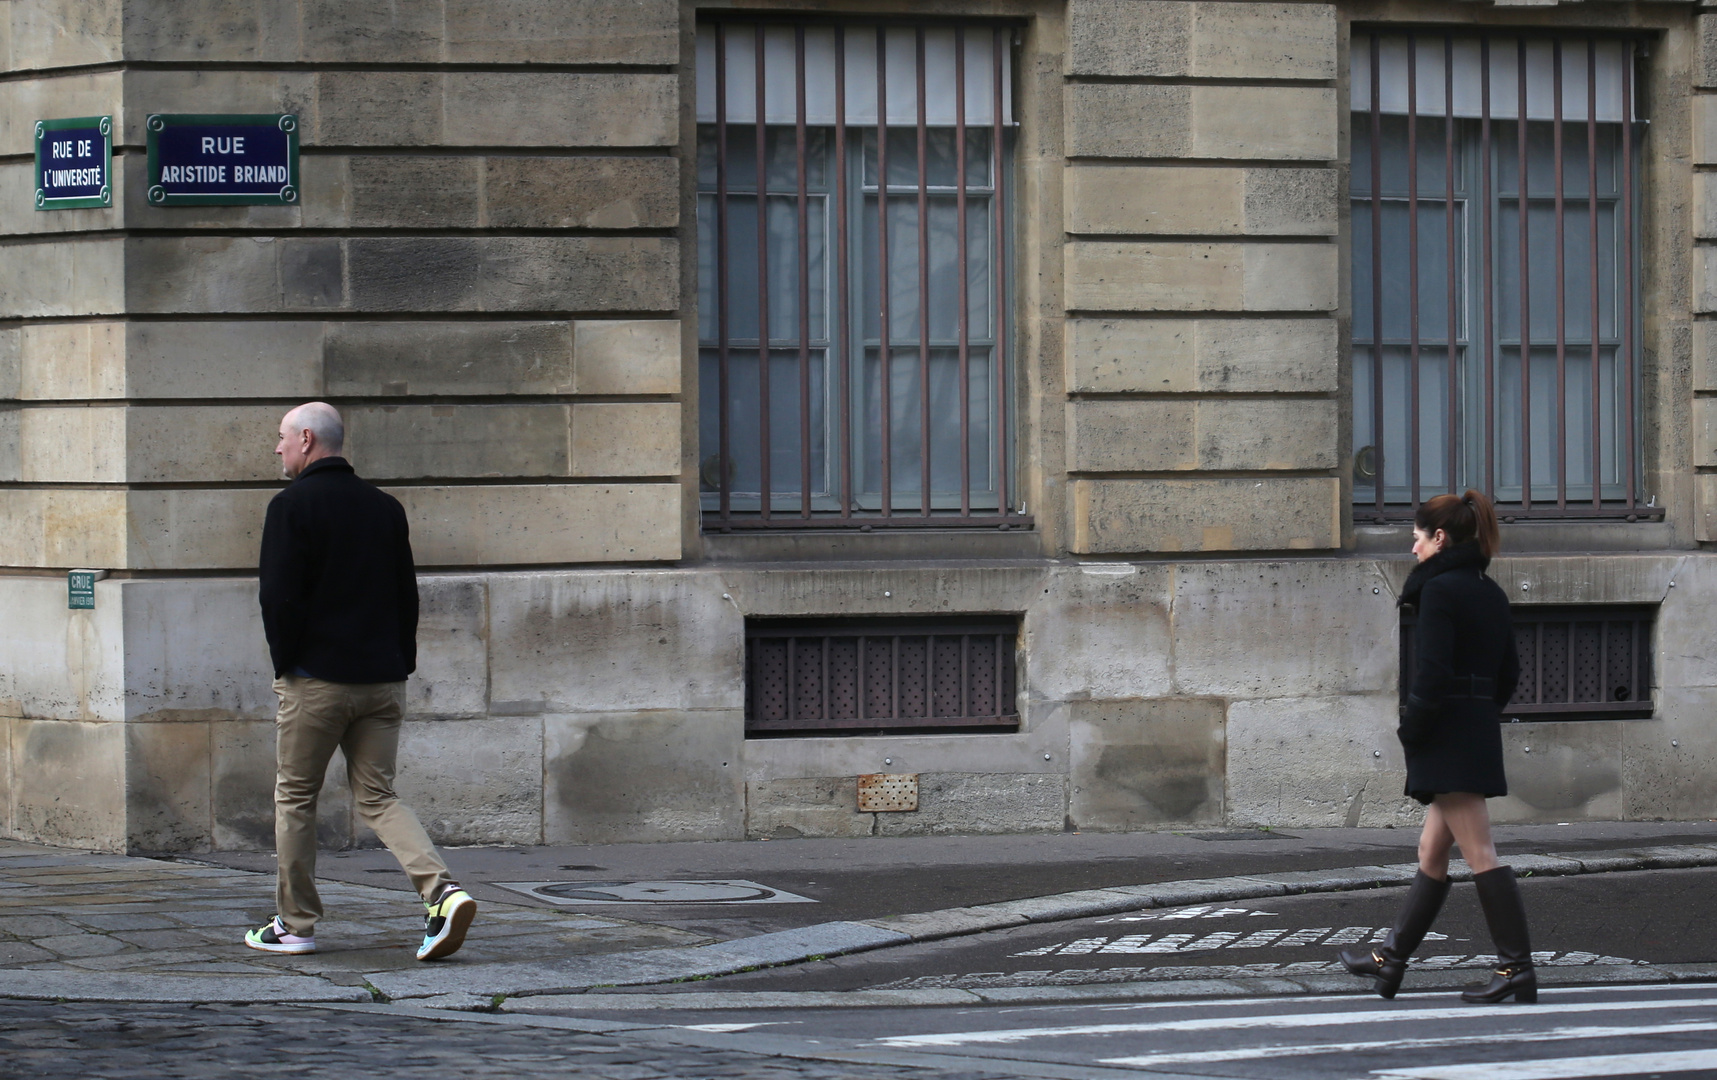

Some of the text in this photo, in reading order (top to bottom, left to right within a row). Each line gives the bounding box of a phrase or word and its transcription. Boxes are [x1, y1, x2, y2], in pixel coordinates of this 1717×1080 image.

[52, 139, 91, 159] RUE DE
[201, 136, 245, 154] RUE
[44, 165, 101, 188] L'UNIVERSITÉ
[161, 165, 287, 183] ARISTIDE BRIAND
[71, 575, 91, 589] CRUE
